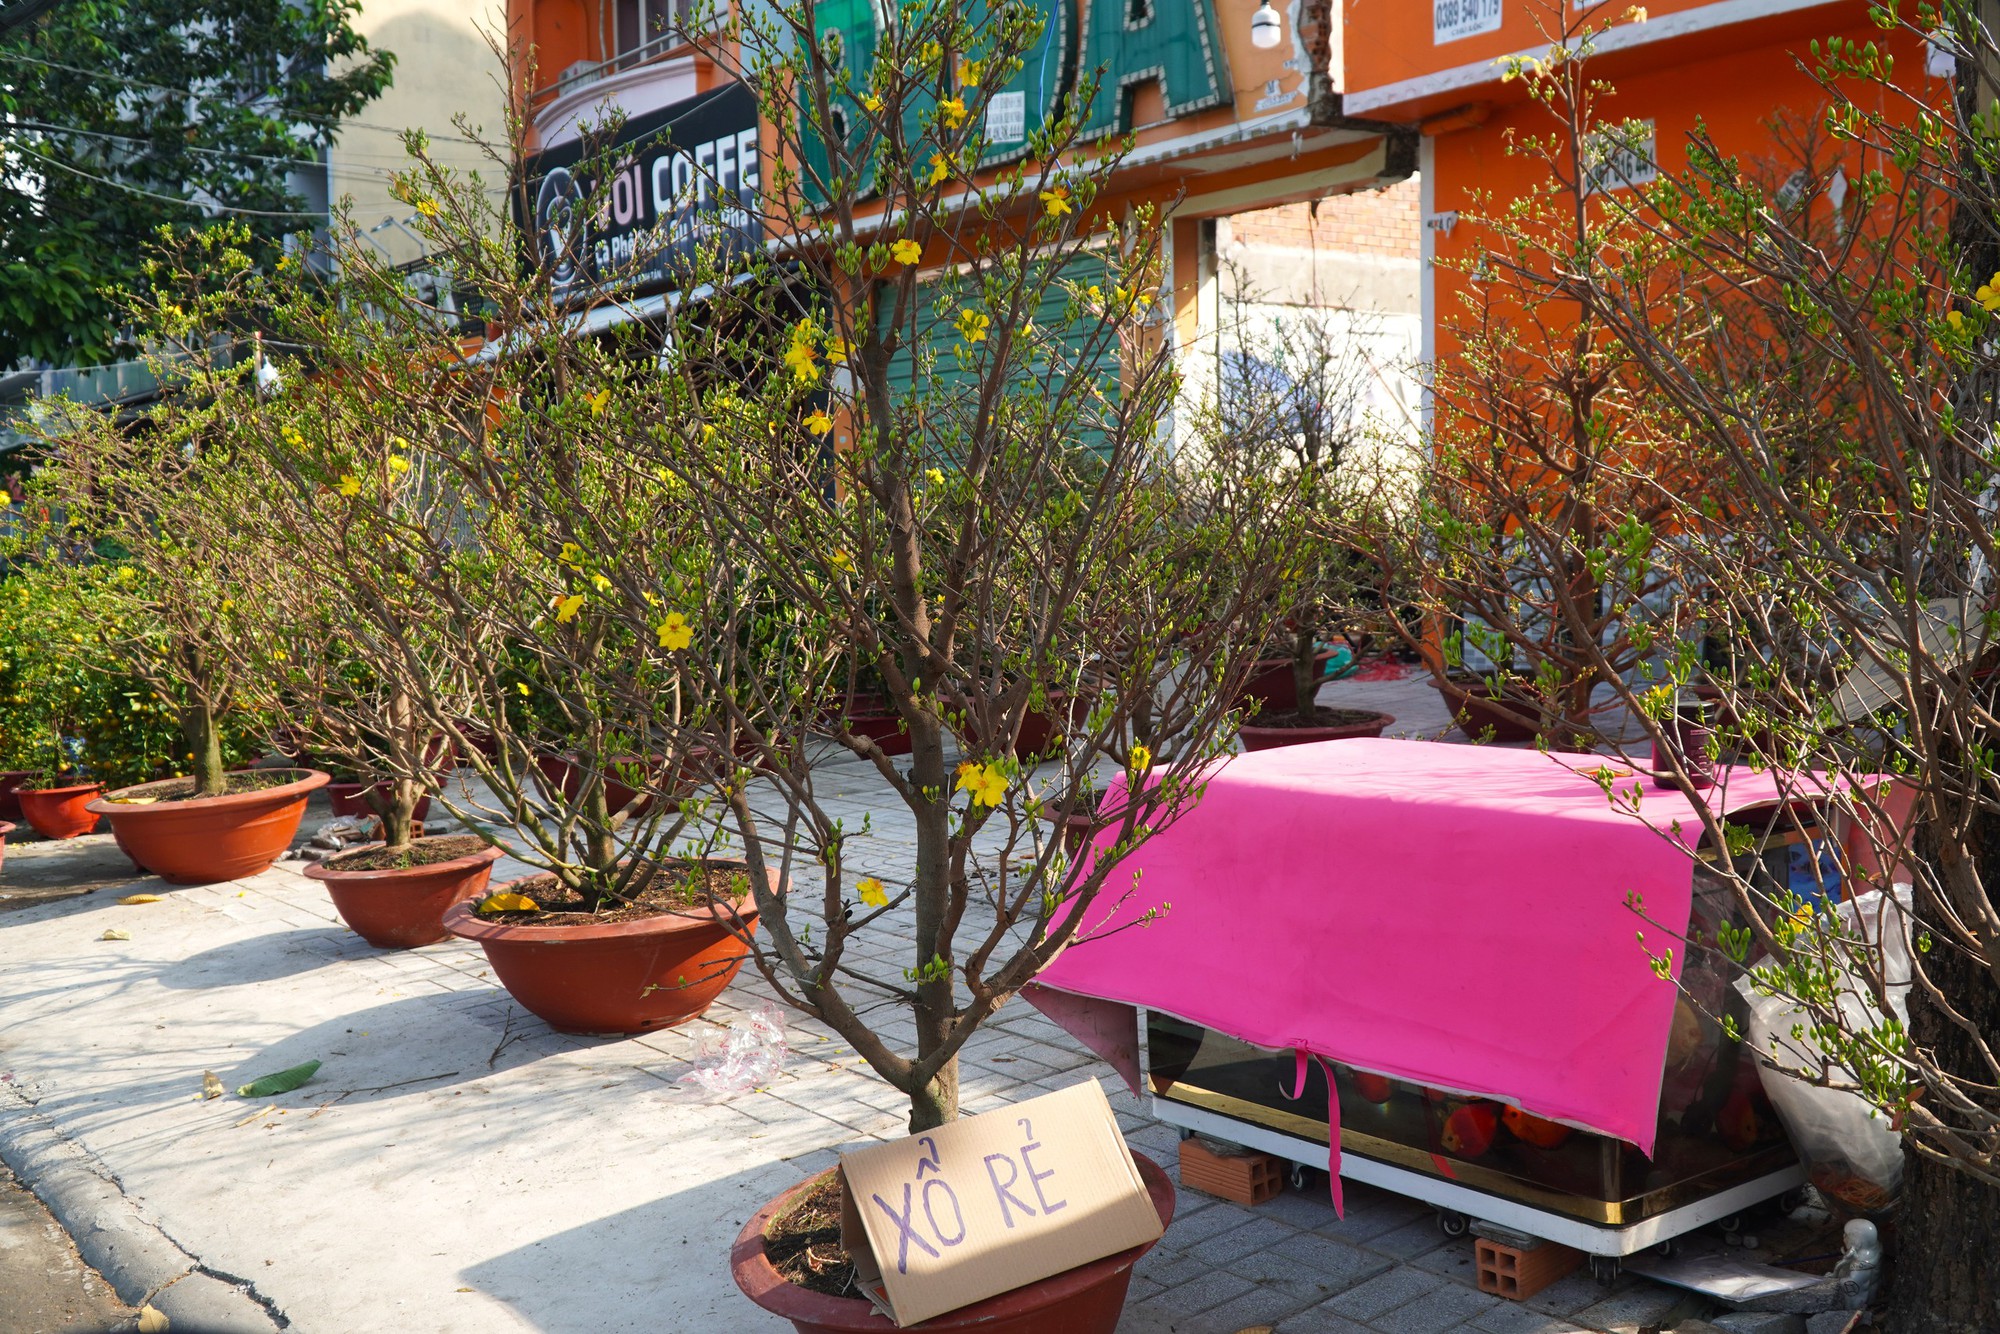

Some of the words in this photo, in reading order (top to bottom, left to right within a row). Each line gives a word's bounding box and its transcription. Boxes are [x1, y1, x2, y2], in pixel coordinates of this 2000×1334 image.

[651, 127, 759, 213] COFFE
[872, 1137, 966, 1275] XỔ
[984, 1118, 1067, 1228] RẺ
